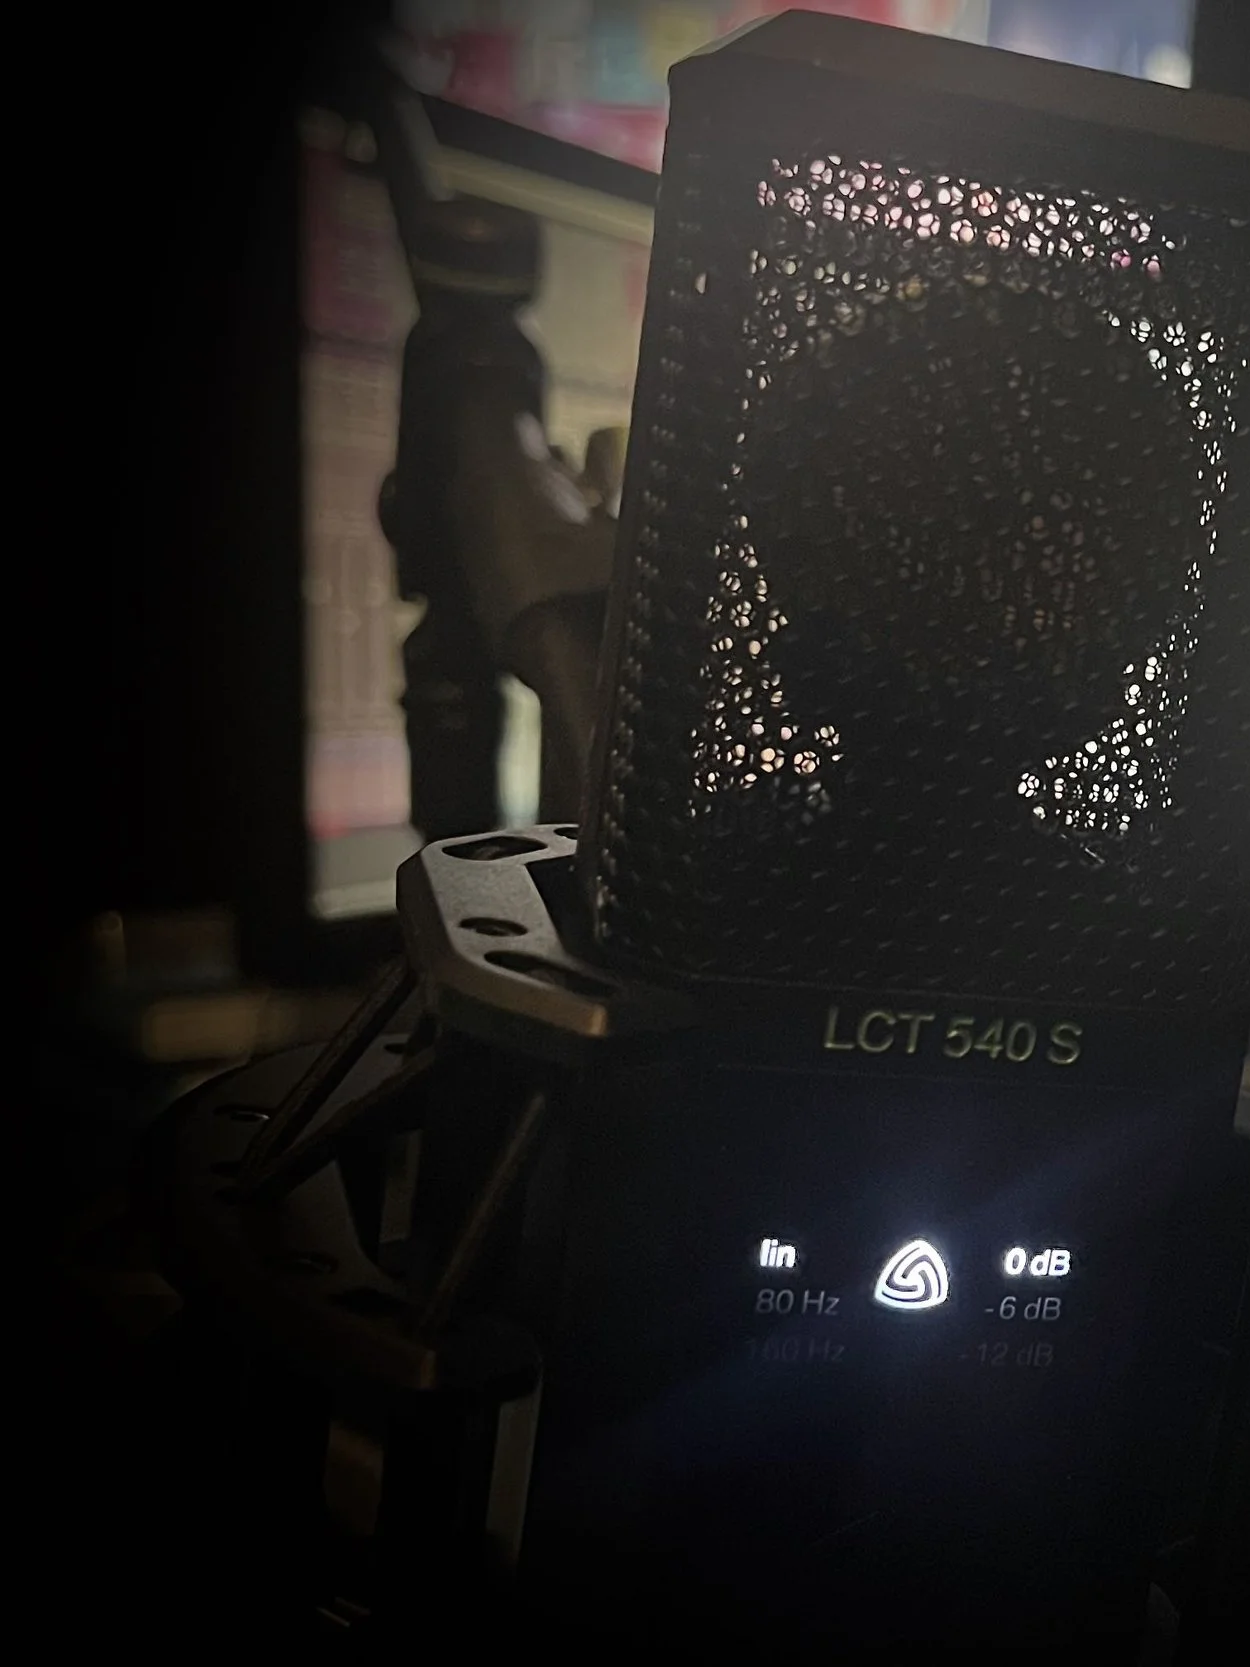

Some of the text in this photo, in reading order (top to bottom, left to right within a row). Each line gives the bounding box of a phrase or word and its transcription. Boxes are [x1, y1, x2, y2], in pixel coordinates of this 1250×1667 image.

[823, 1006, 1083, 1066] LCT 540 S
[758, 1238, 797, 1268] lin
[1003, 1249, 1071, 1277] 0 dB
[755, 1289, 839, 1316] 80 Hz
[1023, 1296, 1061, 1321] dB
[808, 1338, 845, 1363] Hz
[1016, 1343, 1053, 1368] dB
